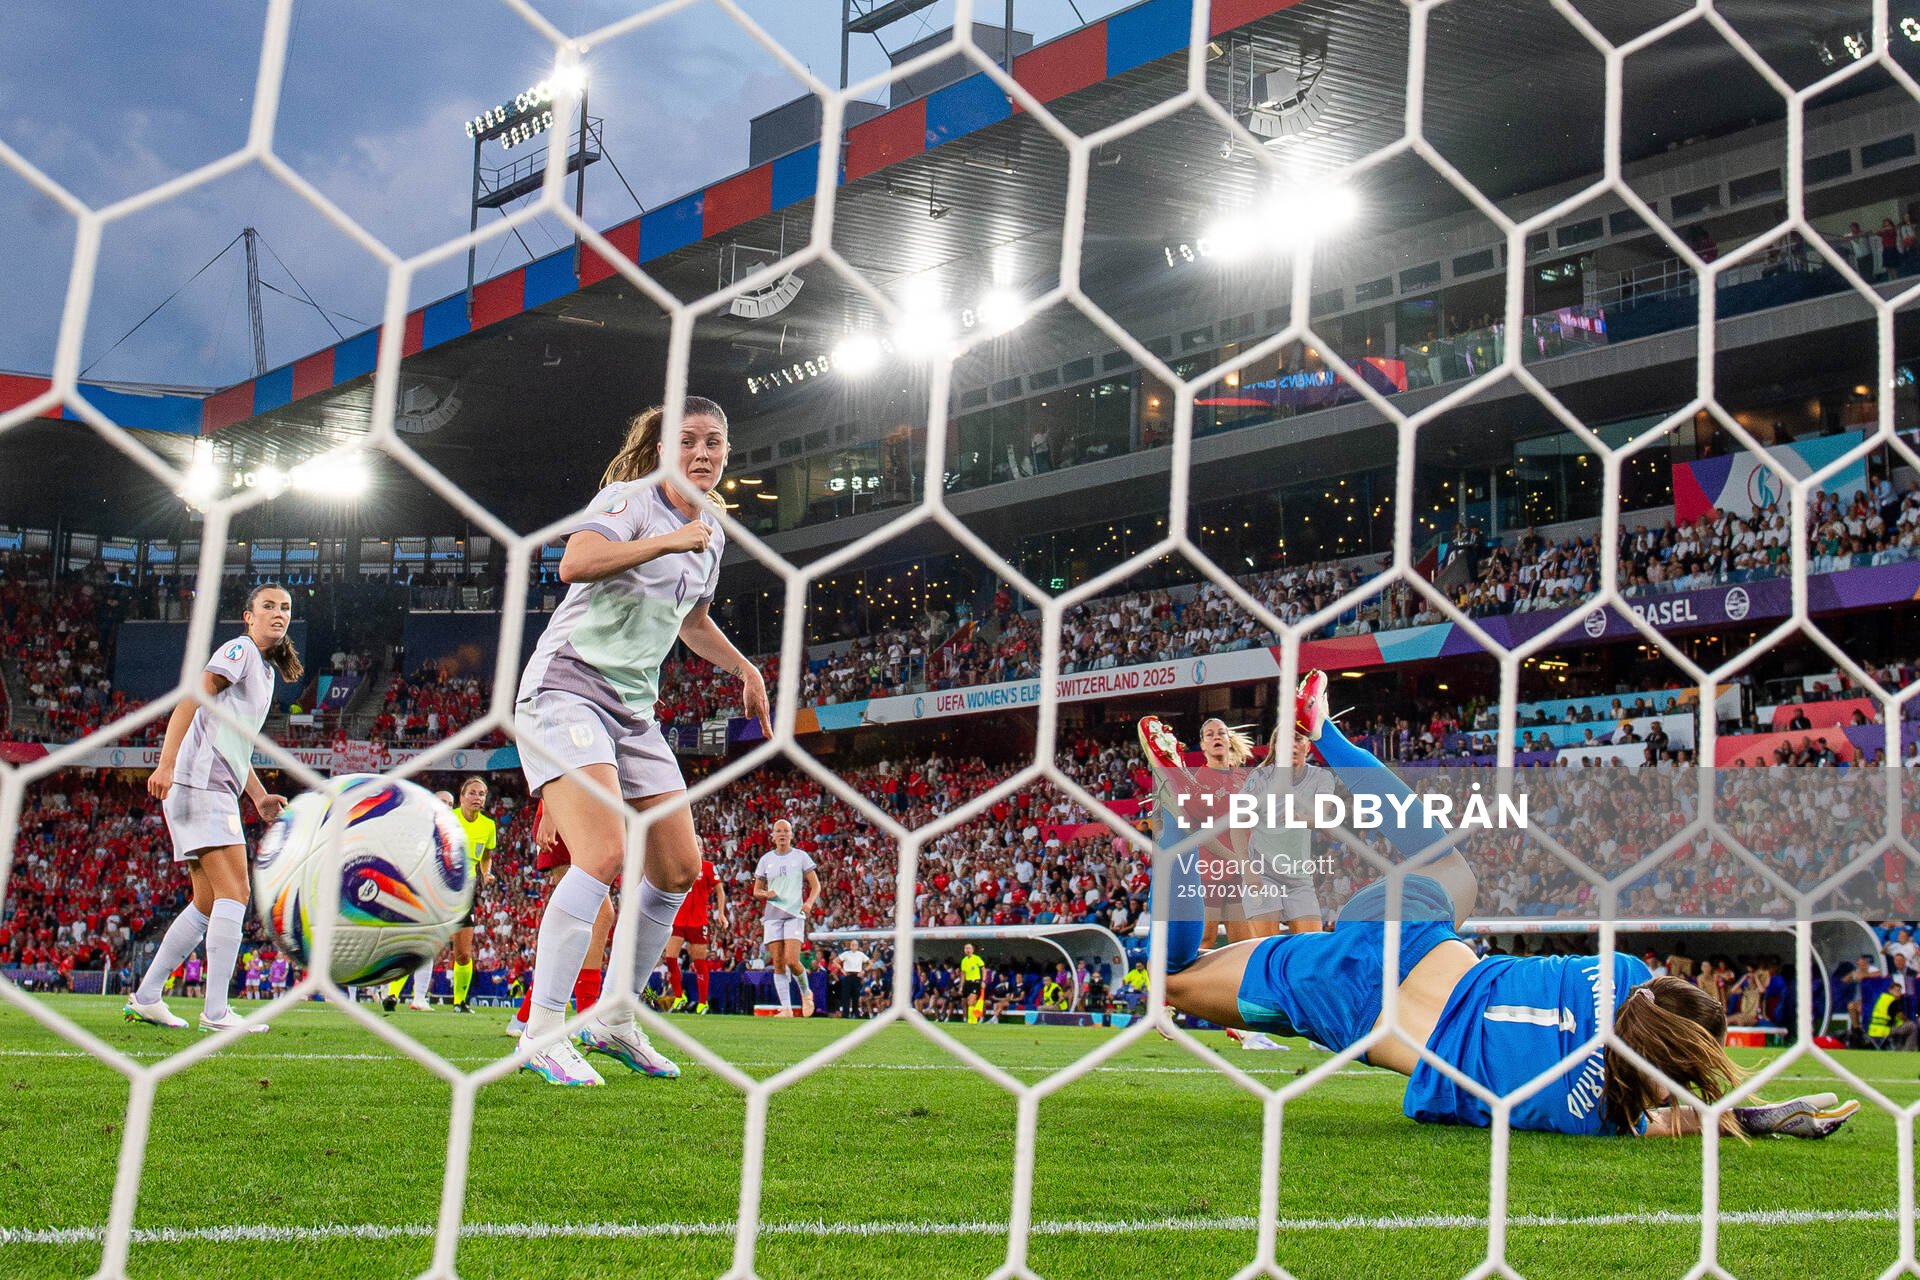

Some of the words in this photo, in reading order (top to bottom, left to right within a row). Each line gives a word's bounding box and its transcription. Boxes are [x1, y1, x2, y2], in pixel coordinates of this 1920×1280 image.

[331, 686, 349, 699] D7
[937, 696, 966, 712] UEFA
[967, 687, 1017, 709] WOMEN'S
[1021, 685, 1041, 705] EUR
[1056, 671, 1139, 698] SWITZERLAND
[1143, 666, 1176, 687] 2025
